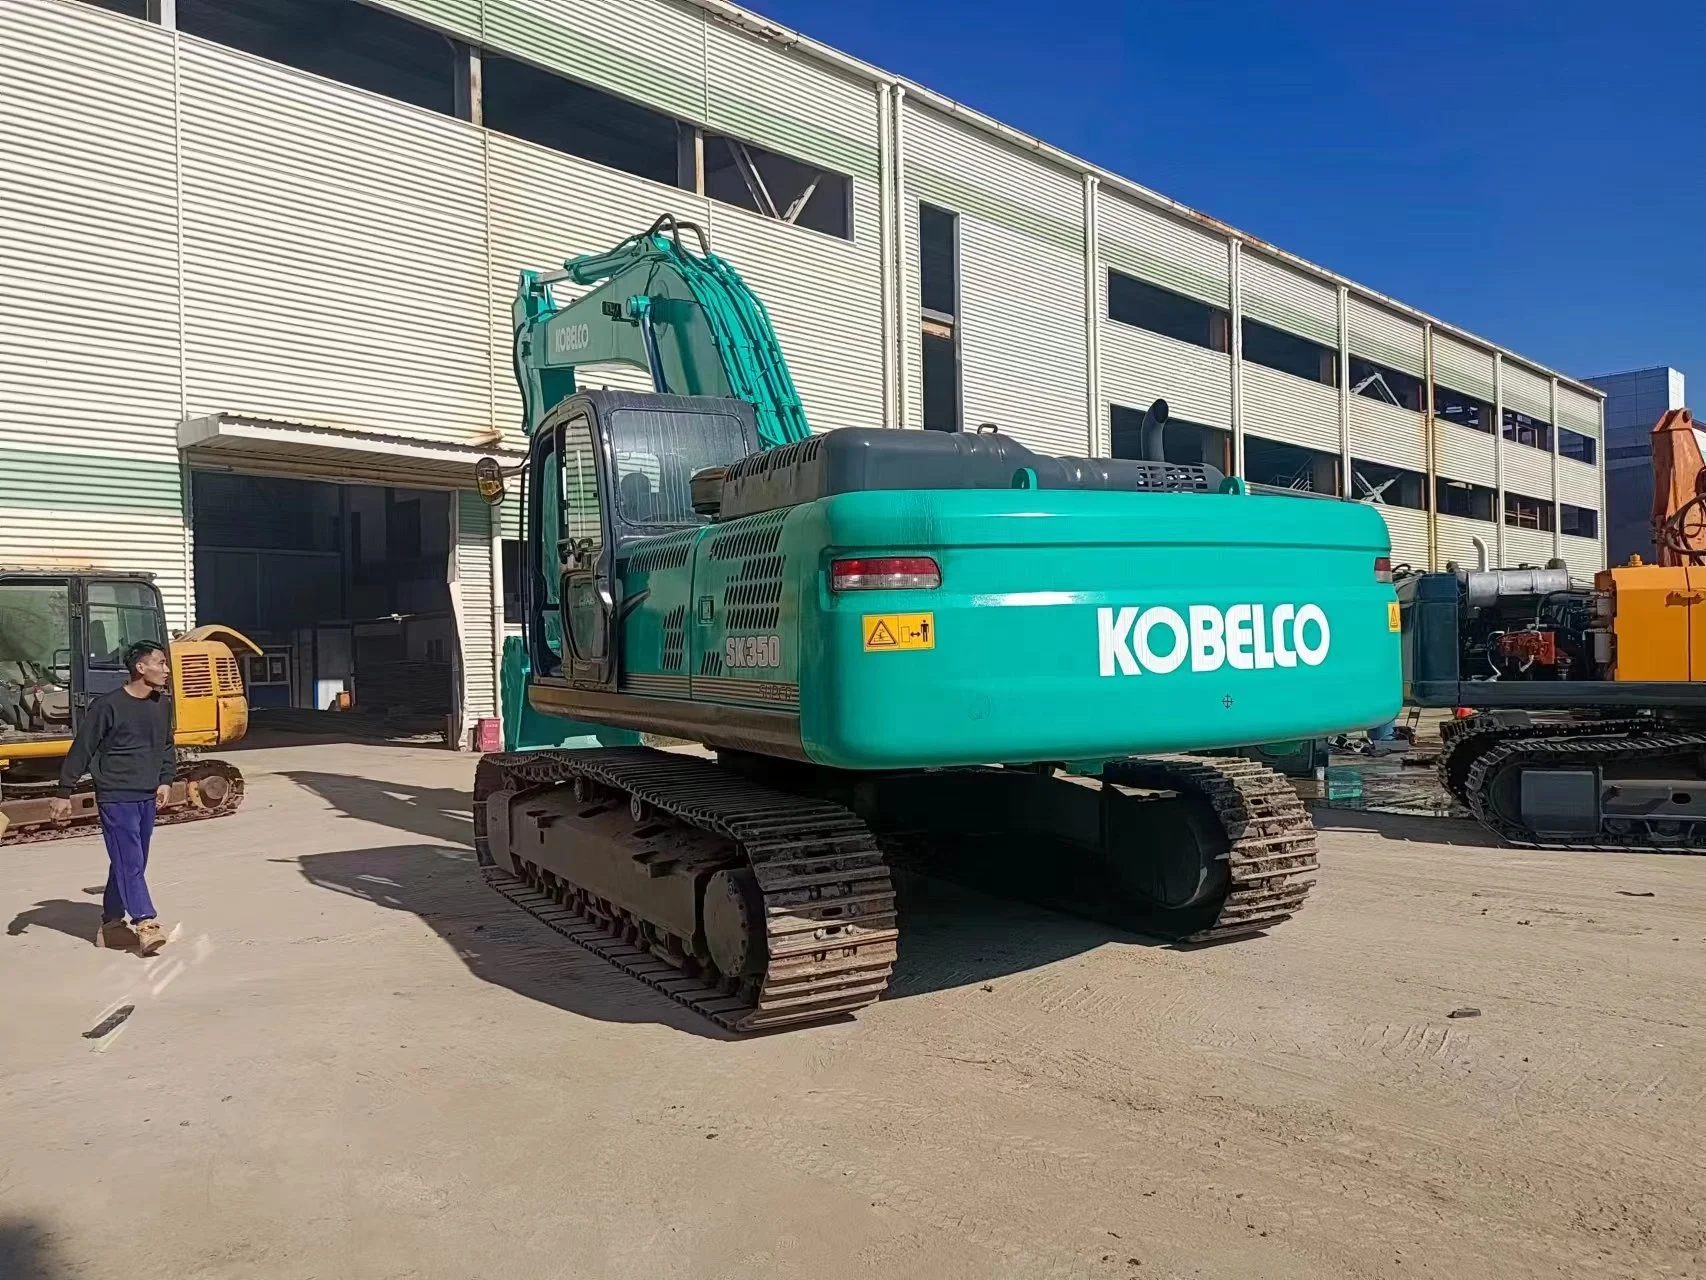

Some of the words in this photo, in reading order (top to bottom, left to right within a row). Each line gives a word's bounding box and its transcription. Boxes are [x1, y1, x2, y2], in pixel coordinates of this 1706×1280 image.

[555, 323, 589, 352] KOBELCO
[726, 635, 780, 668] SK350
[1097, 603, 1331, 677] KOBELCO
